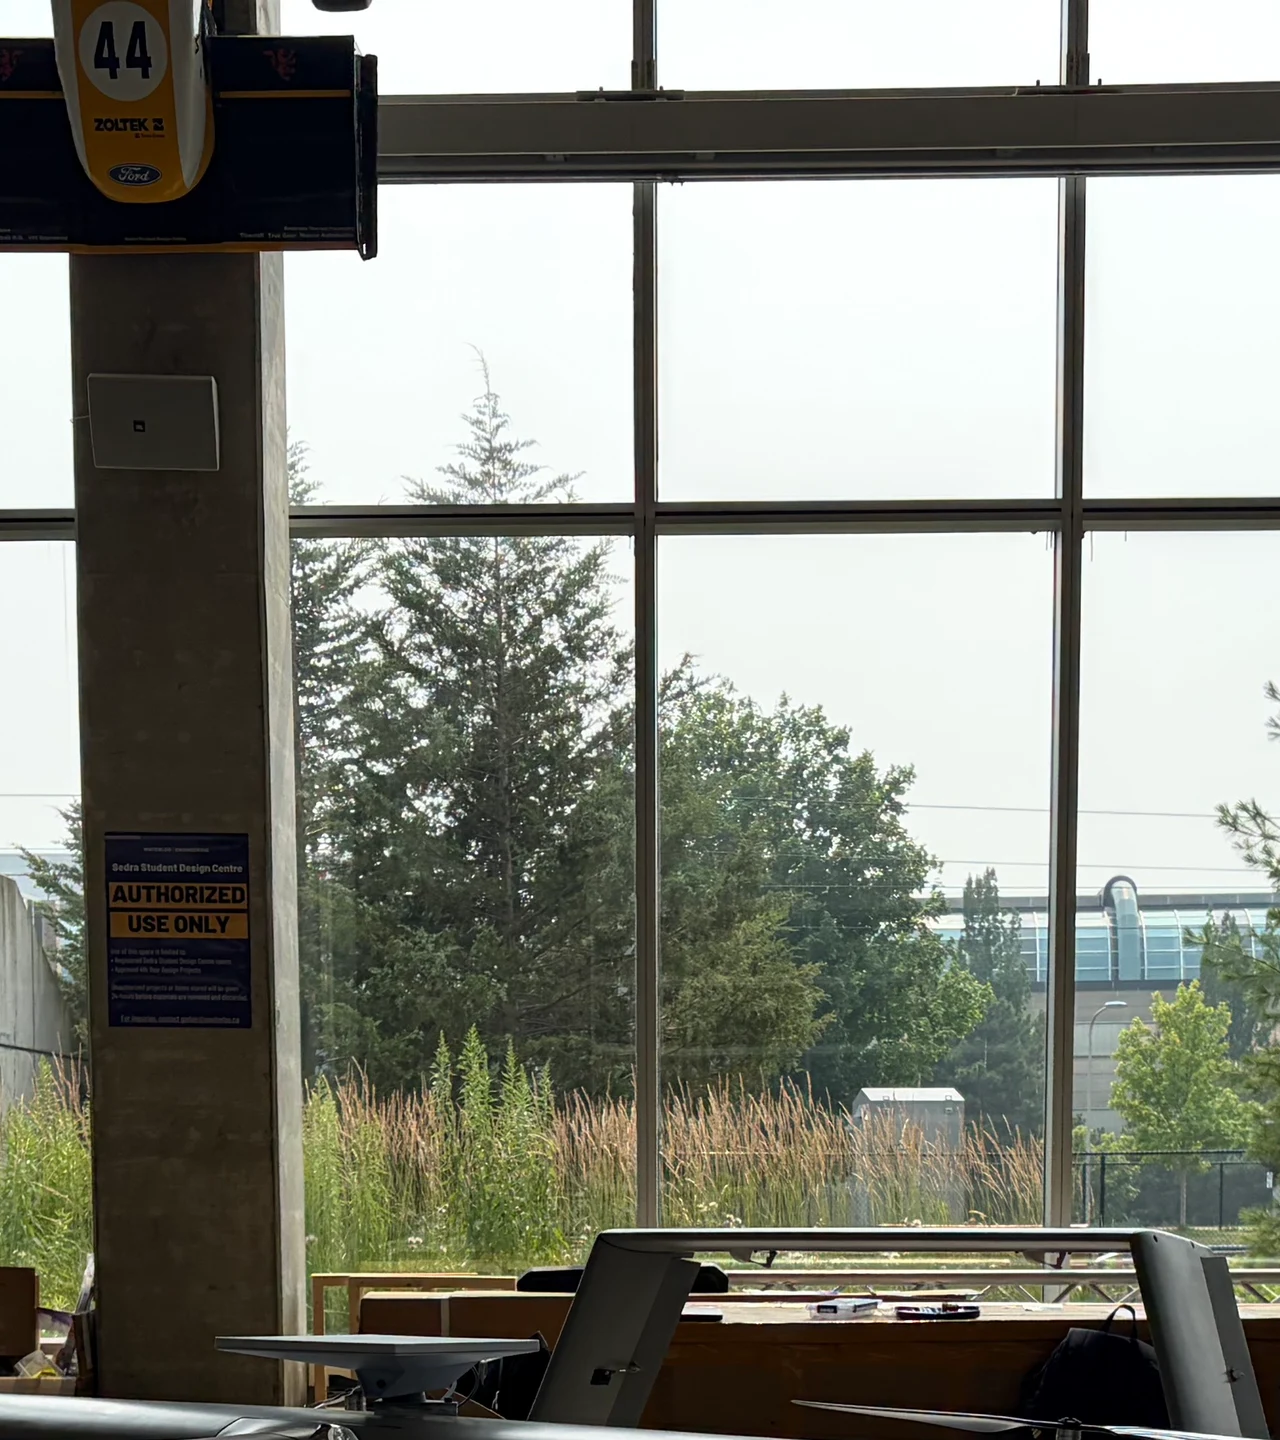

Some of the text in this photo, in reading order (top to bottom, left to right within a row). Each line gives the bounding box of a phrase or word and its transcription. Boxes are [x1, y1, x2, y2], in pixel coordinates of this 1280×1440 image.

[94, 20, 153, 80] 44
[93, 118, 149, 132] ZOLTEK
[117, 166, 151, 182] Ford
[112, 862, 244, 875] Sedra Student Design Centre
[111, 885, 245, 904] AUTHORIZED
[128, 915, 230, 934] USE ONLY
